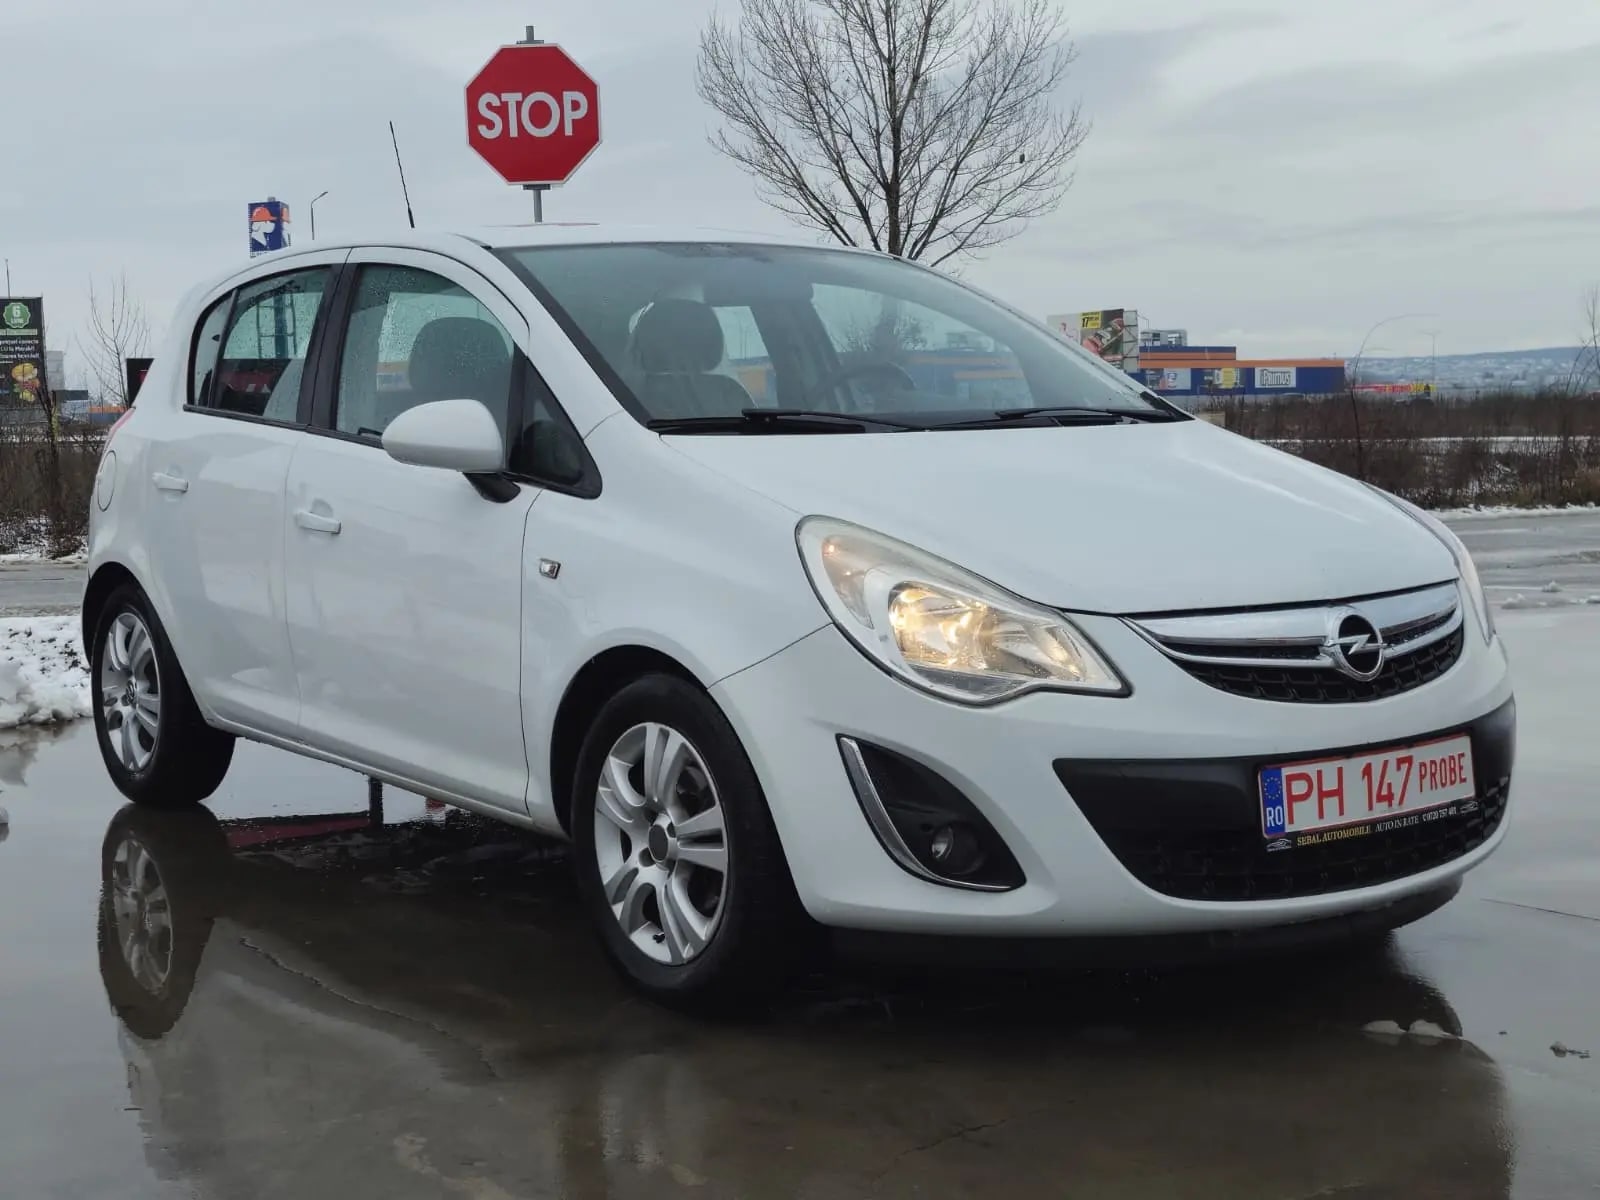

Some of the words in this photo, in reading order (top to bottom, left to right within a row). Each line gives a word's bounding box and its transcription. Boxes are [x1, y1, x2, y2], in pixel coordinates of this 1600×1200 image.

[477, 91, 589, 139] STOP
[1285, 766, 1345, 825] PH
[1361, 754, 1414, 812] 147
[1418, 752, 1467, 793] PROBE
[1266, 805, 1284, 827] RO
[1375, 820, 1394, 832] AUTO
[1394, 818, 1403, 829] IN
[1403, 815, 1420, 827] RATE
